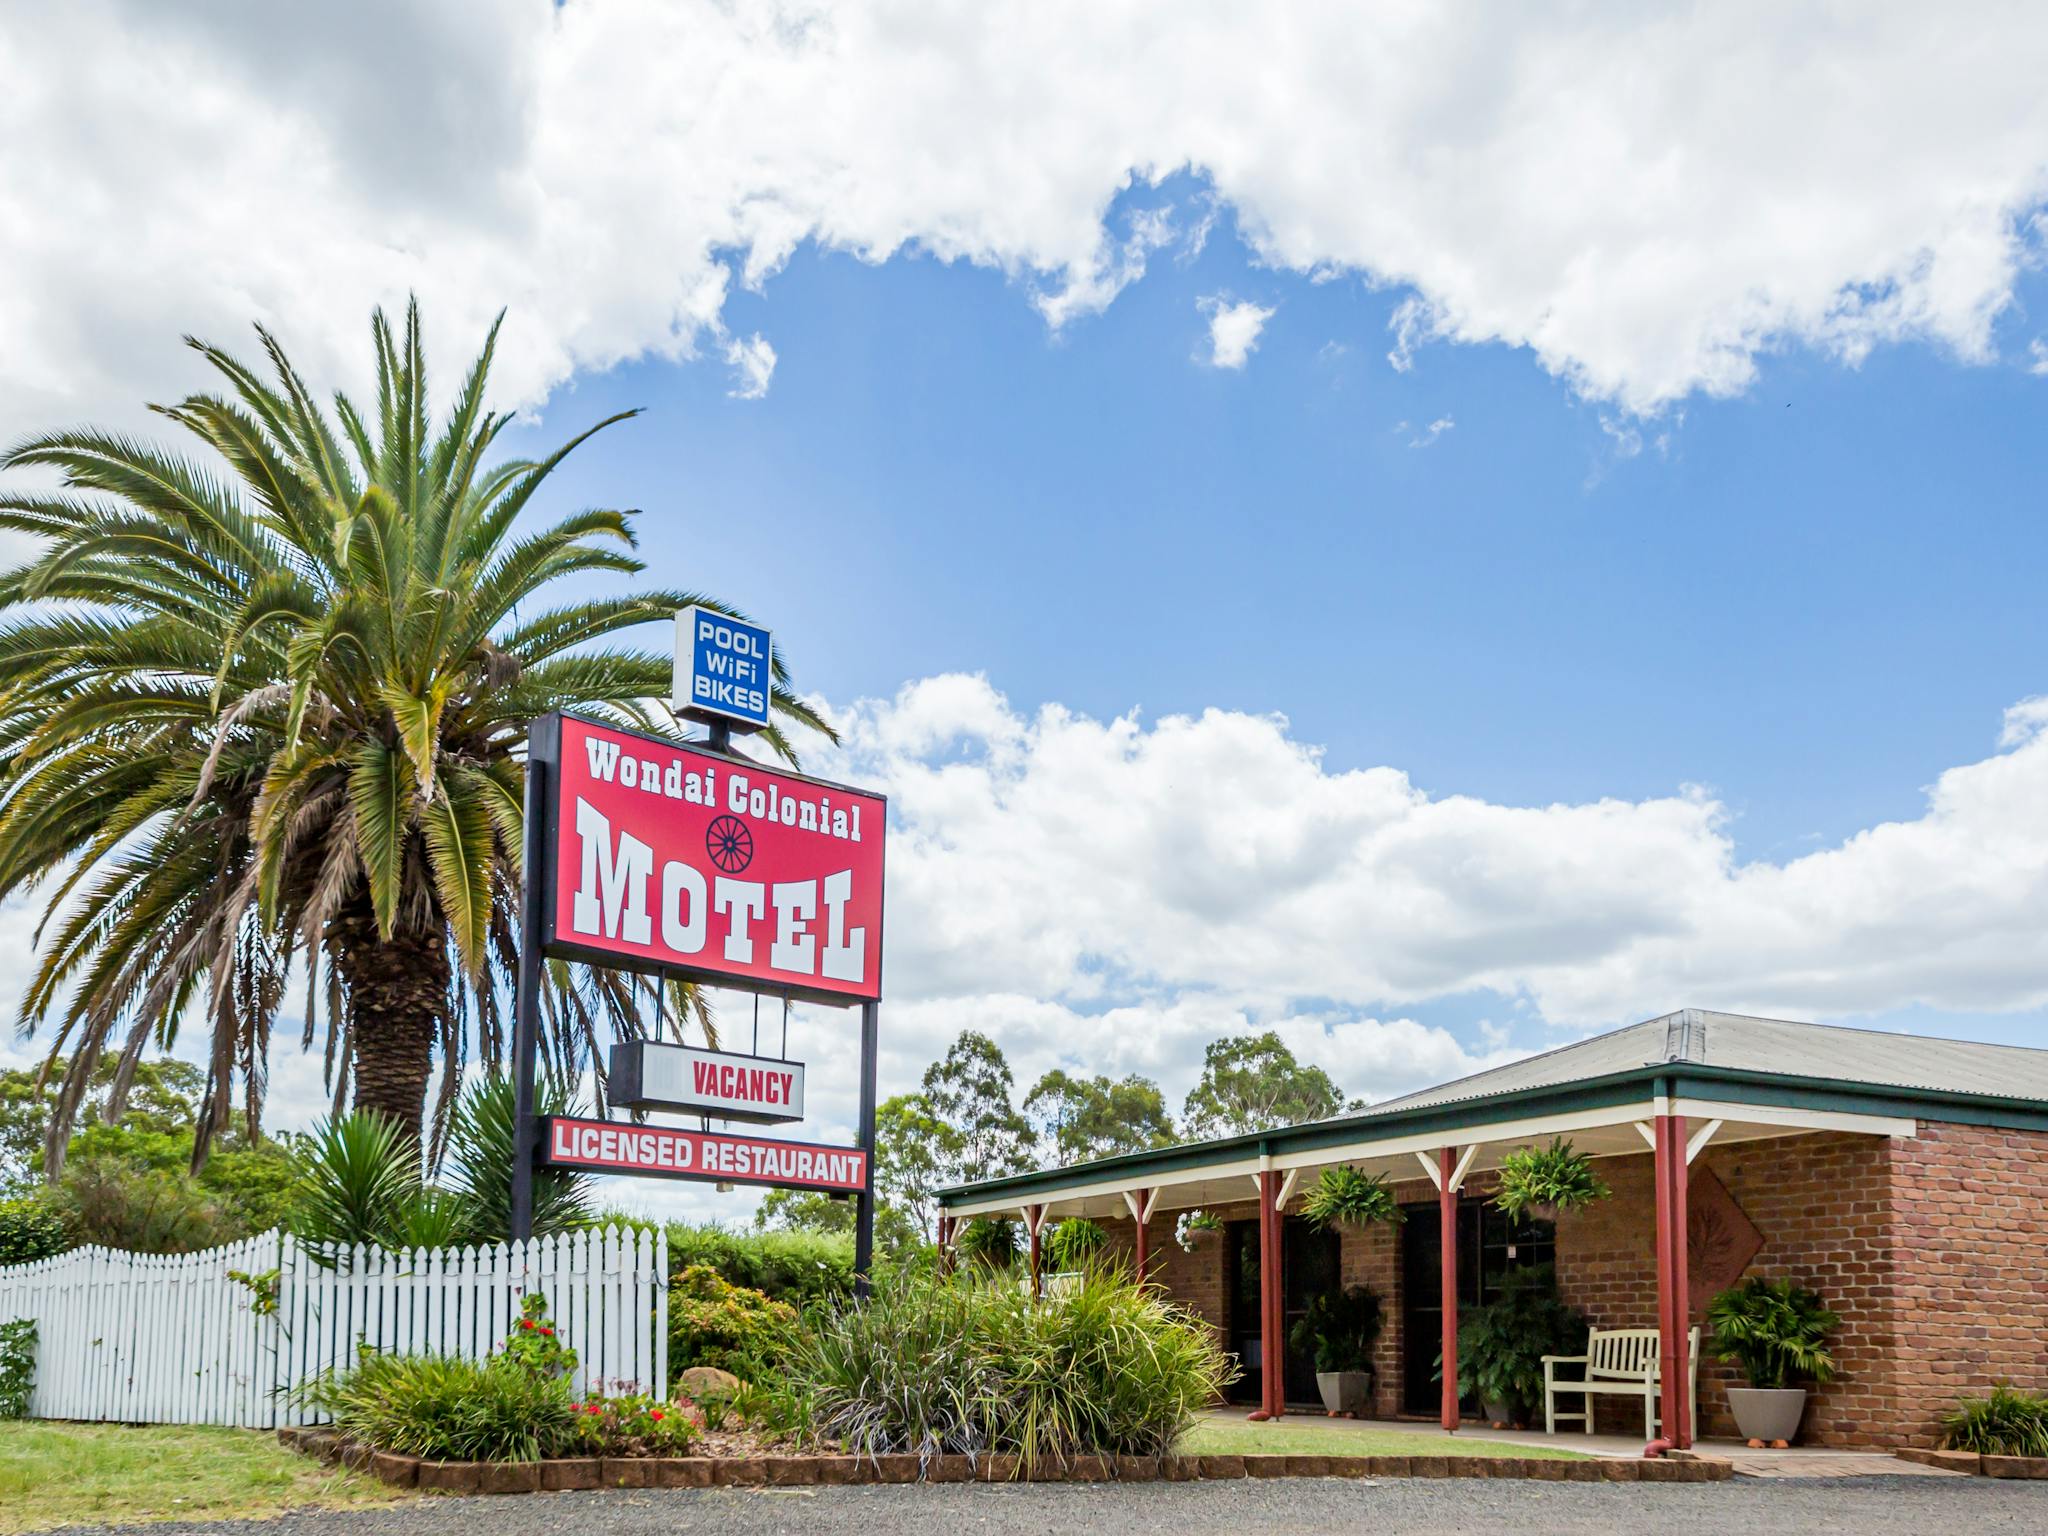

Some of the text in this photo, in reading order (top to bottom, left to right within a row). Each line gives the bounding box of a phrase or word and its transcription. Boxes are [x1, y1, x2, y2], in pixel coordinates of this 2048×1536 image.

[699, 621, 763, 659] POOL
[706, 650, 756, 684] WiFi
[695, 674, 764, 713] BIKES
[585, 736, 861, 842] Wondai Colonial
[573, 795, 865, 983] MOTEL
[693, 1061, 793, 1105] VACANCY
[555, 1125, 862, 1184] LICENSED RESTAURANT
